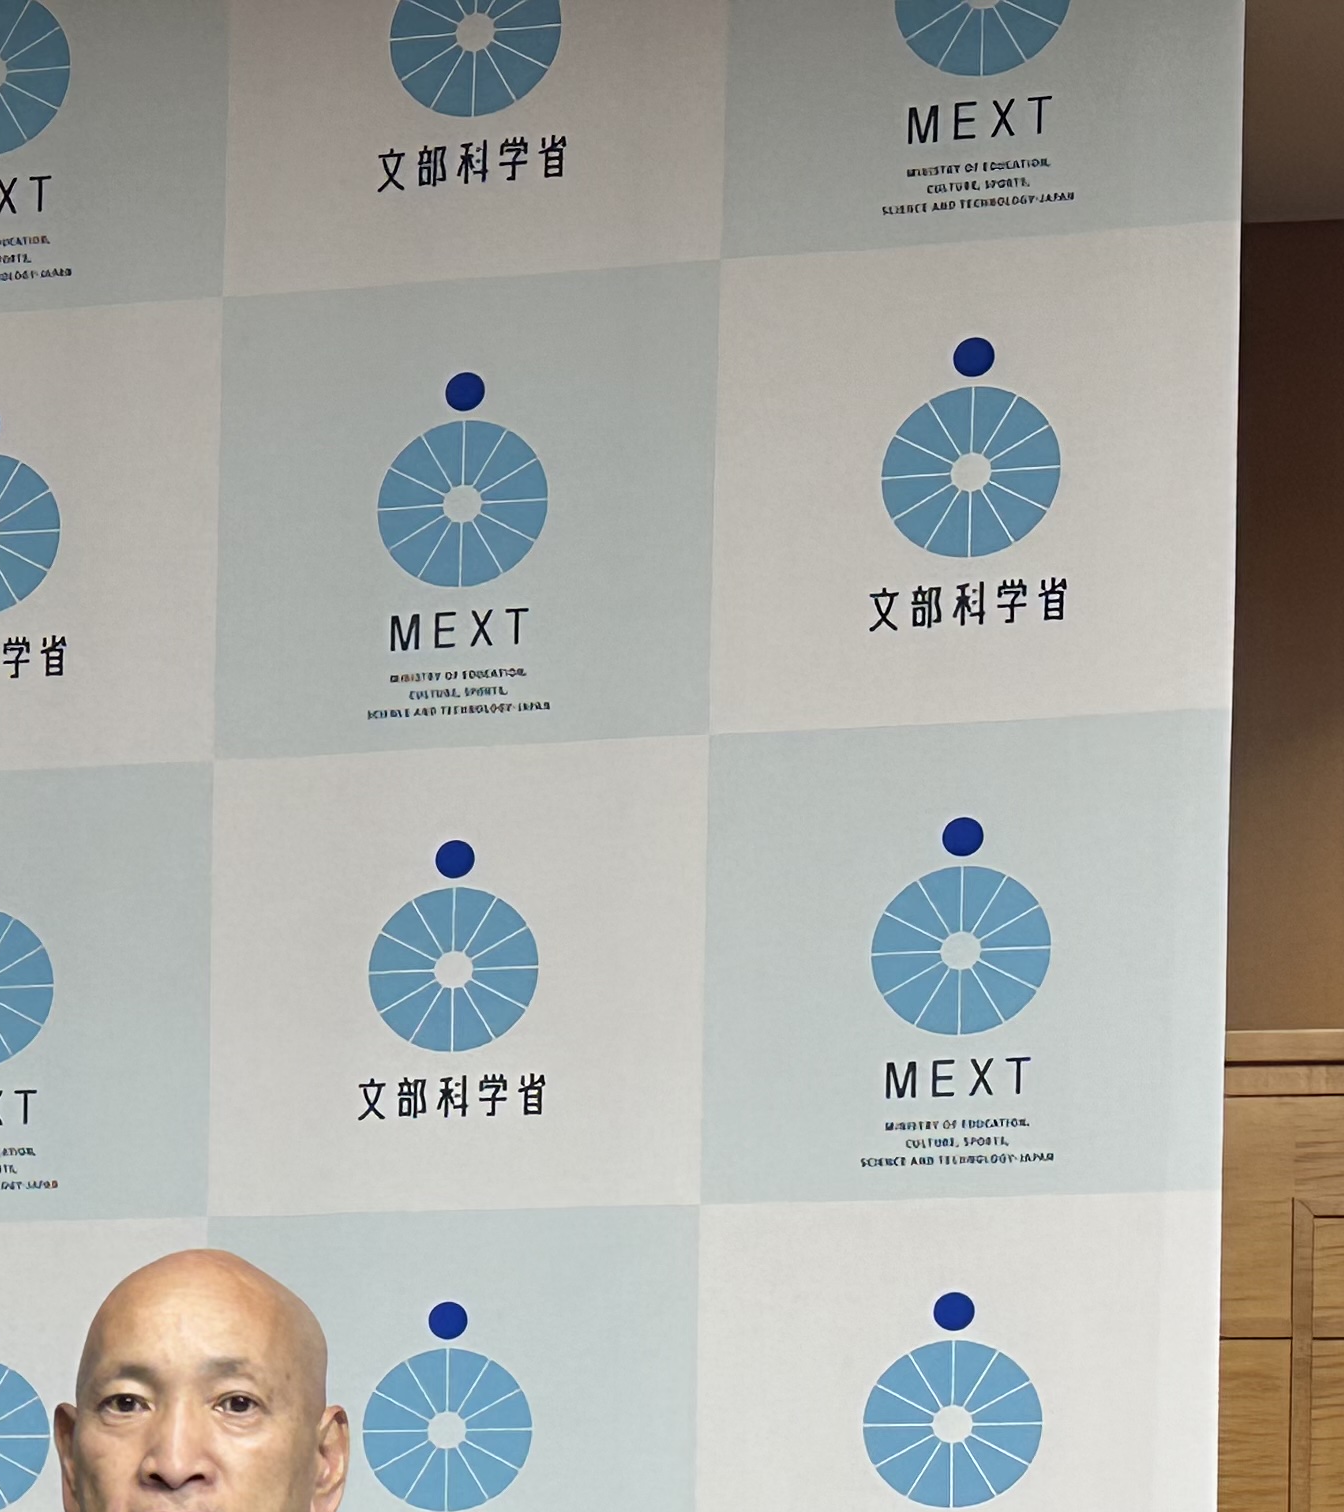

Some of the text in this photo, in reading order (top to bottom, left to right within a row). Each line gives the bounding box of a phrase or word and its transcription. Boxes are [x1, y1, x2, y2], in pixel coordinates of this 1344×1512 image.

[908, 96, 1052, 144] MEXT
[378, 135, 566, 192] 文部科学省
[932, 201, 956, 212] AND
[869, 577, 1067, 632] 文部科学省
[390, 608, 529, 651] MEXT
[358, 1073, 545, 1120] 文部科学省
[886, 1057, 1031, 1099] MEXT
[911, 1156, 934, 1166] AND
